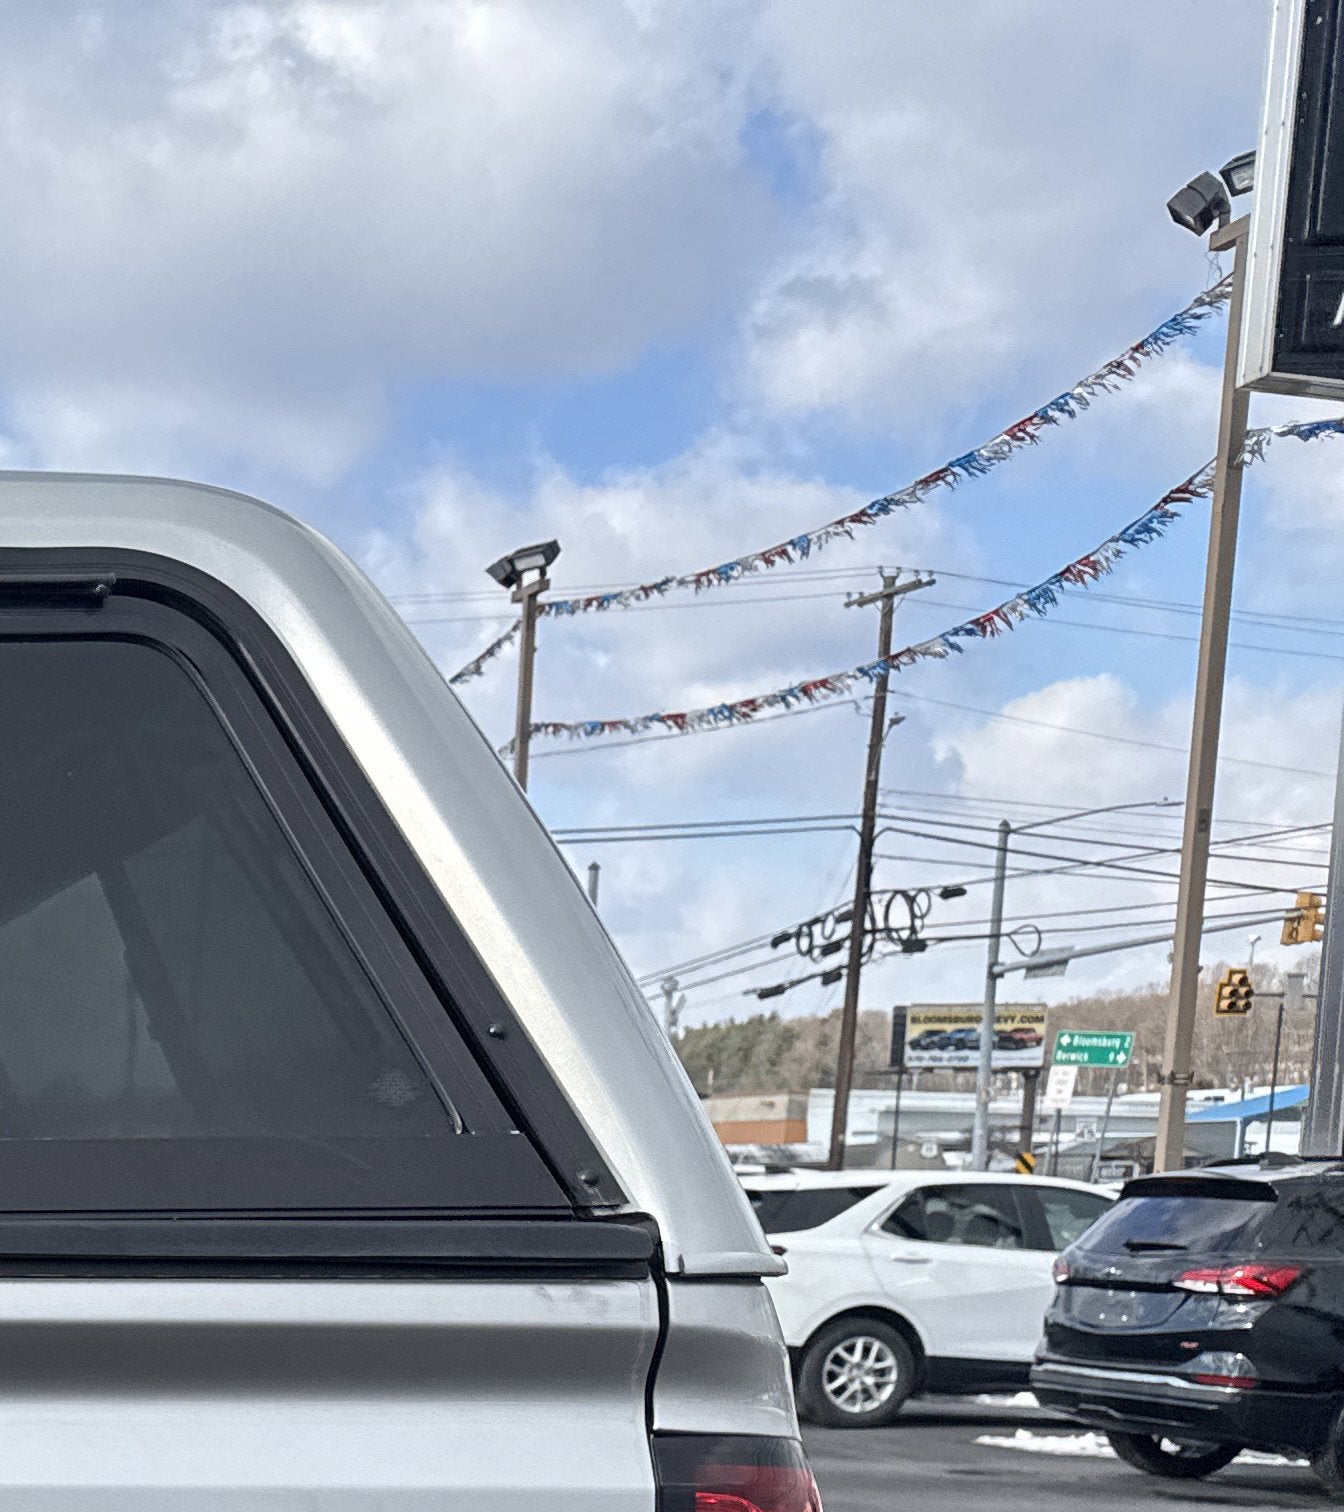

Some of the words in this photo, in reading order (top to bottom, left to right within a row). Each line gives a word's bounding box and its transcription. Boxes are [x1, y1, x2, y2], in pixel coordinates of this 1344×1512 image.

[910, 1014, 1045, 1025] BLOOMSBURGEVY.COM
[1072, 1034, 1121, 1050] Bloomsburg
[1055, 1049, 1089, 1062] Berwick
